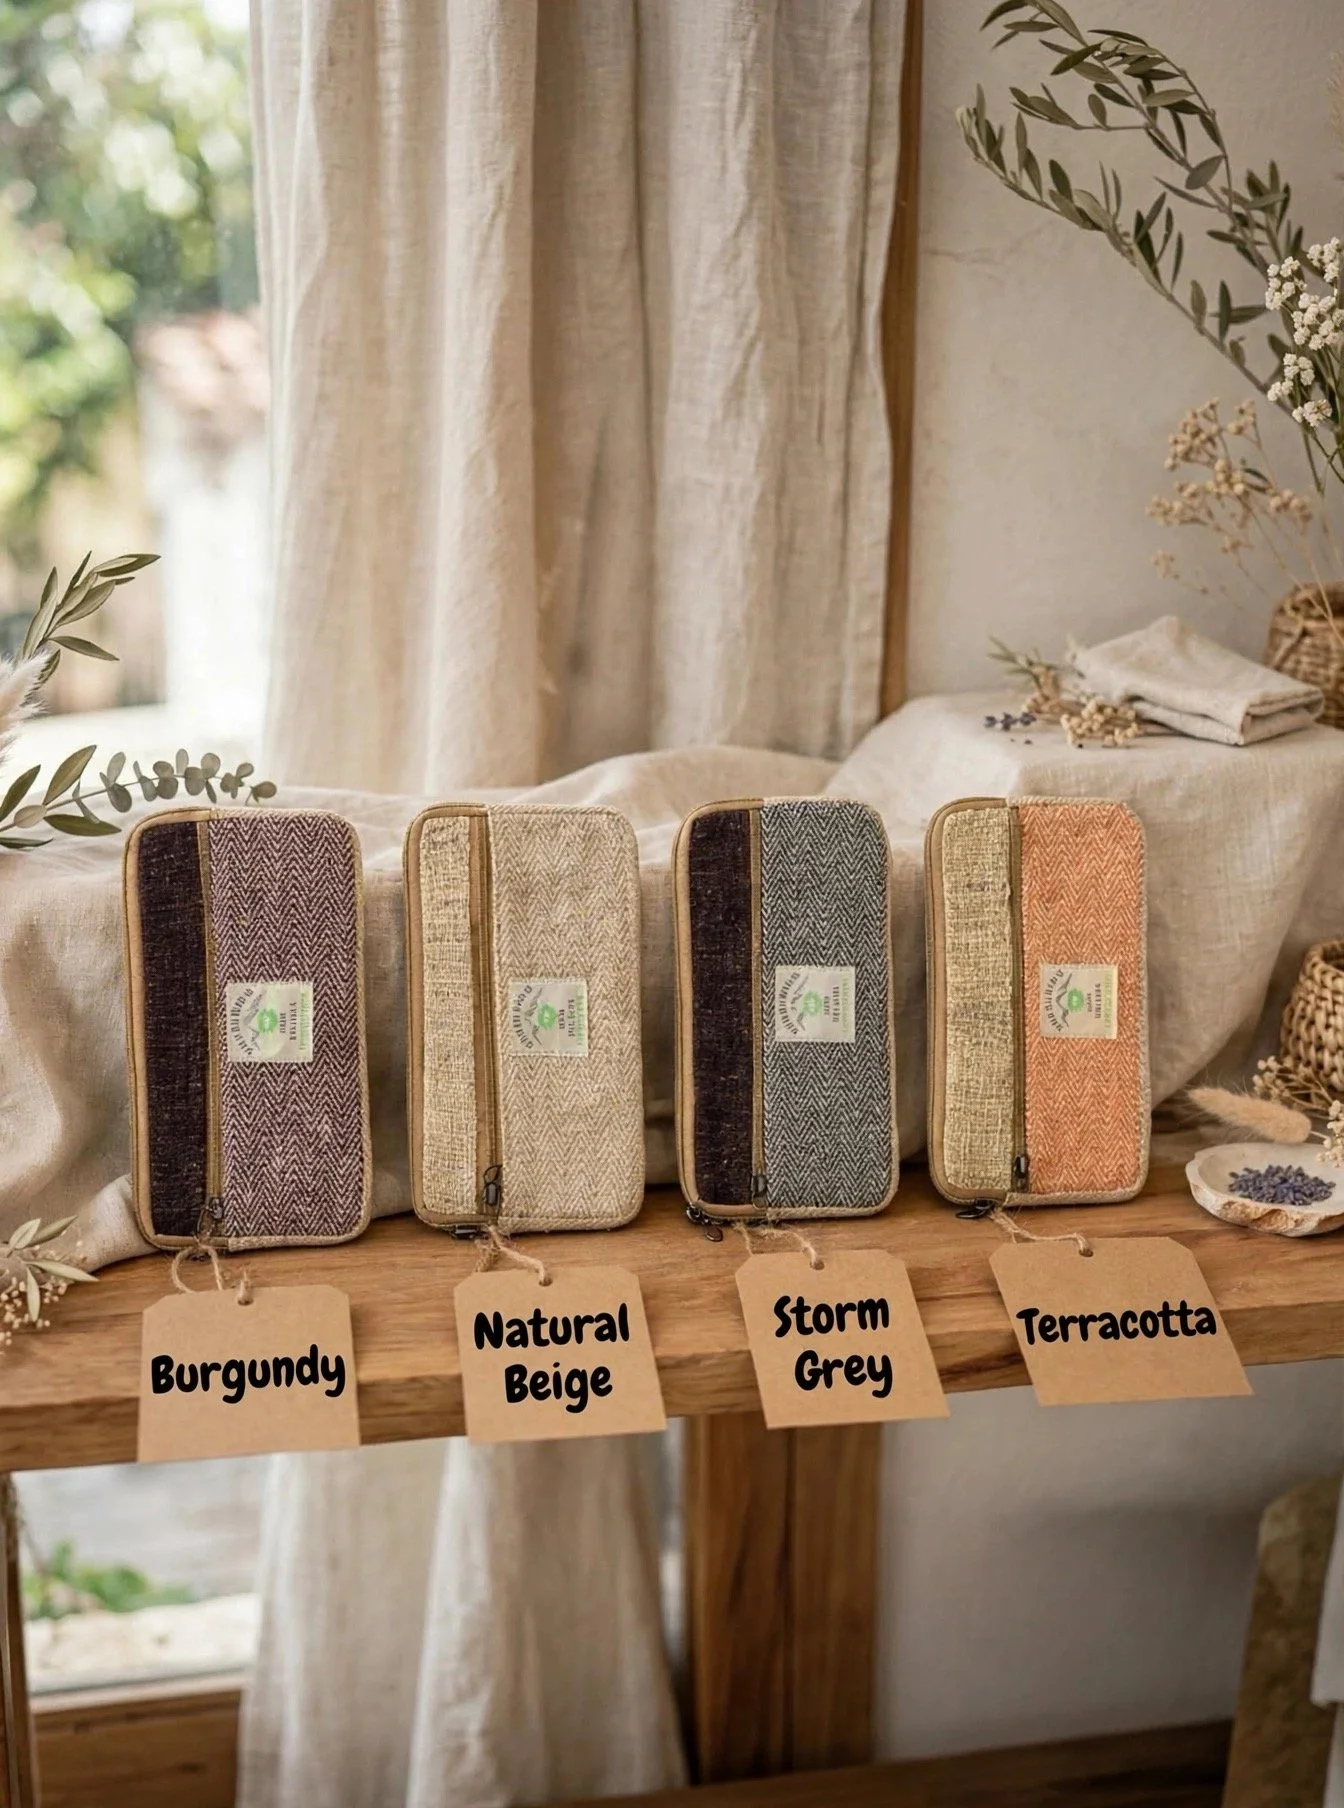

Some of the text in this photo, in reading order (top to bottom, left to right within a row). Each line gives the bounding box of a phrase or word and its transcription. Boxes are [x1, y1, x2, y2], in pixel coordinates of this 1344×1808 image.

[473, 1302, 630, 1350] Natural
[773, 1295, 890, 1338] Storm
[1015, 1299, 1217, 1346] Terracotta
[151, 1343, 346, 1404] Burgundy
[504, 1361, 613, 1414] Beige
[794, 1349, 893, 1399] Grey
